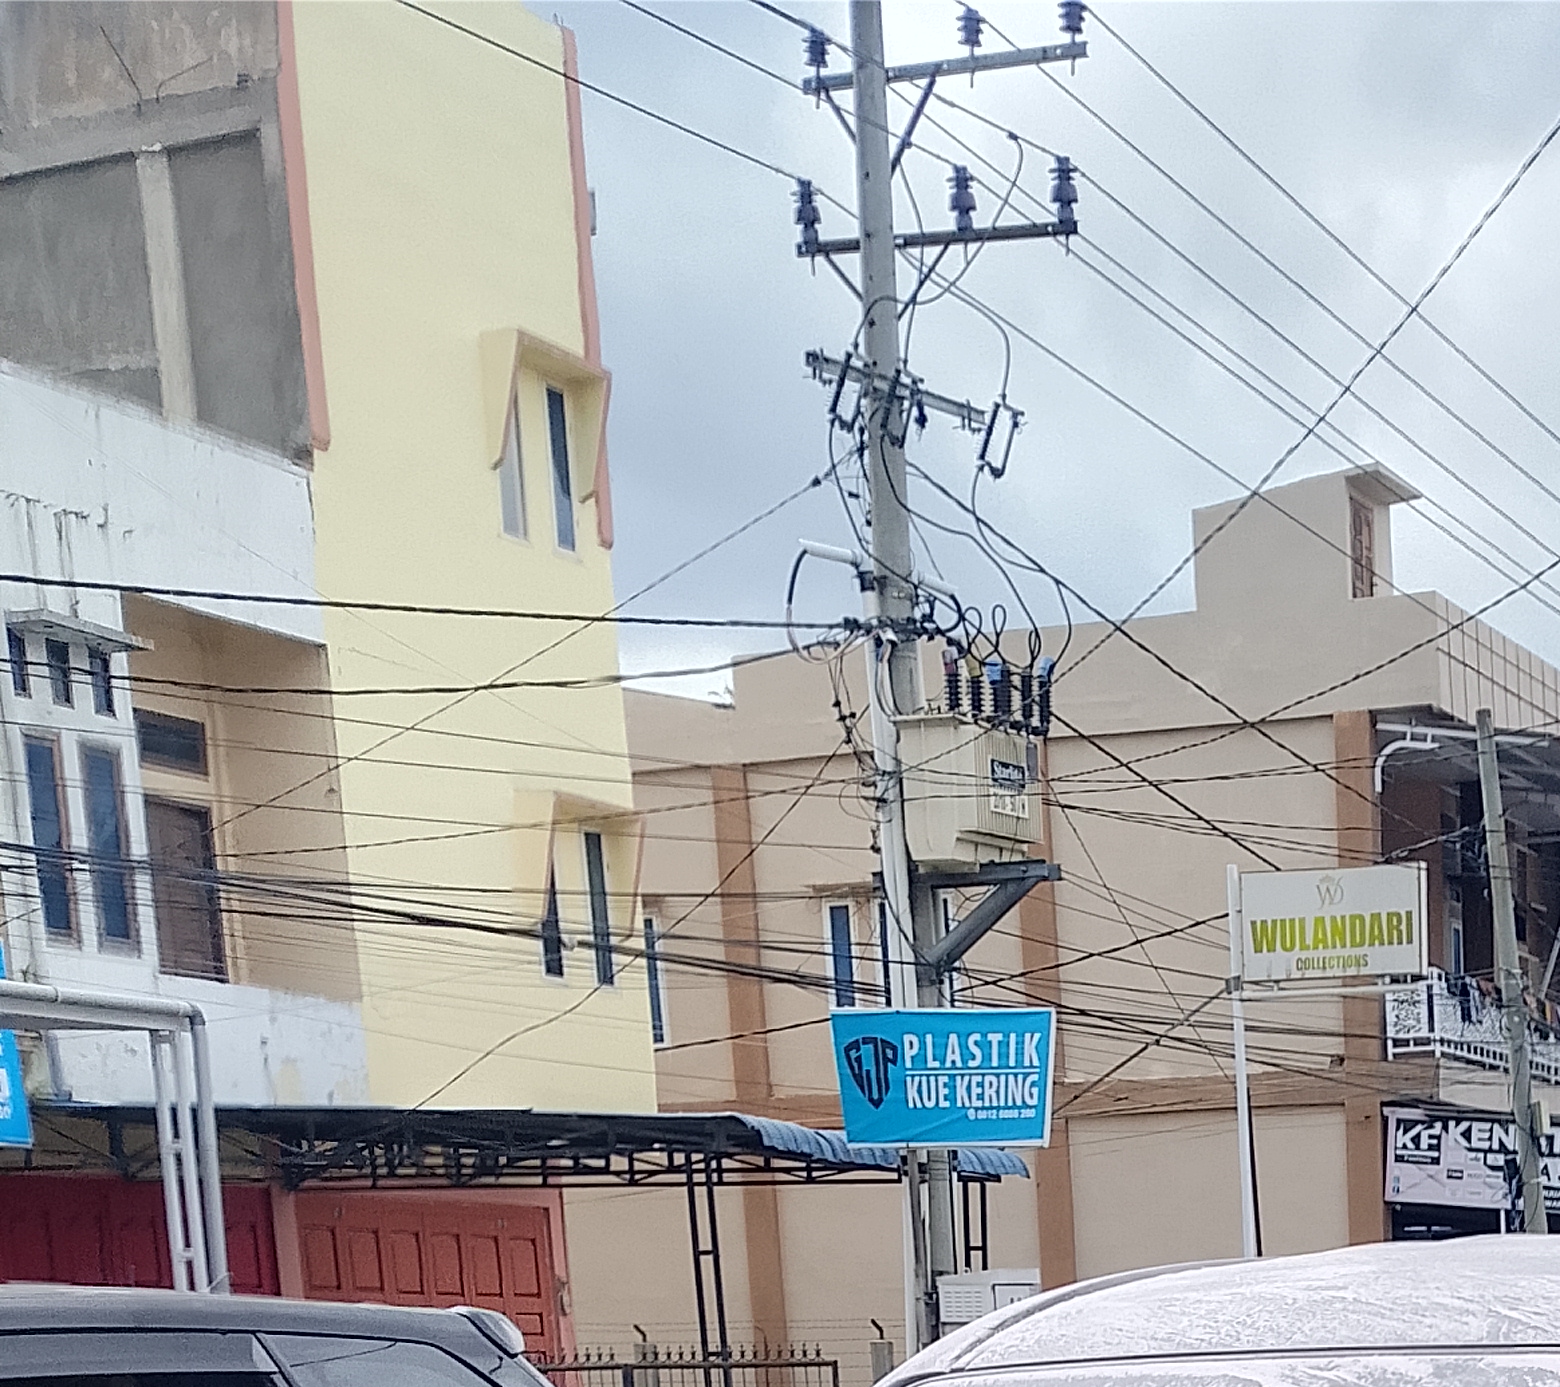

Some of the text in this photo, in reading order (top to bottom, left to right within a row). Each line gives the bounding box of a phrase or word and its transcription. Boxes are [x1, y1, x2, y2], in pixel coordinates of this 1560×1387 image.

[1250, 909, 1414, 954] WULANDARI
[1296, 953, 1369, 971] COLLECTIONS
[902, 1032, 1042, 1069] PLASTIK
[905, 1073, 1040, 1109] KUE KERING
[1396, 1120, 1442, 1151] KF
